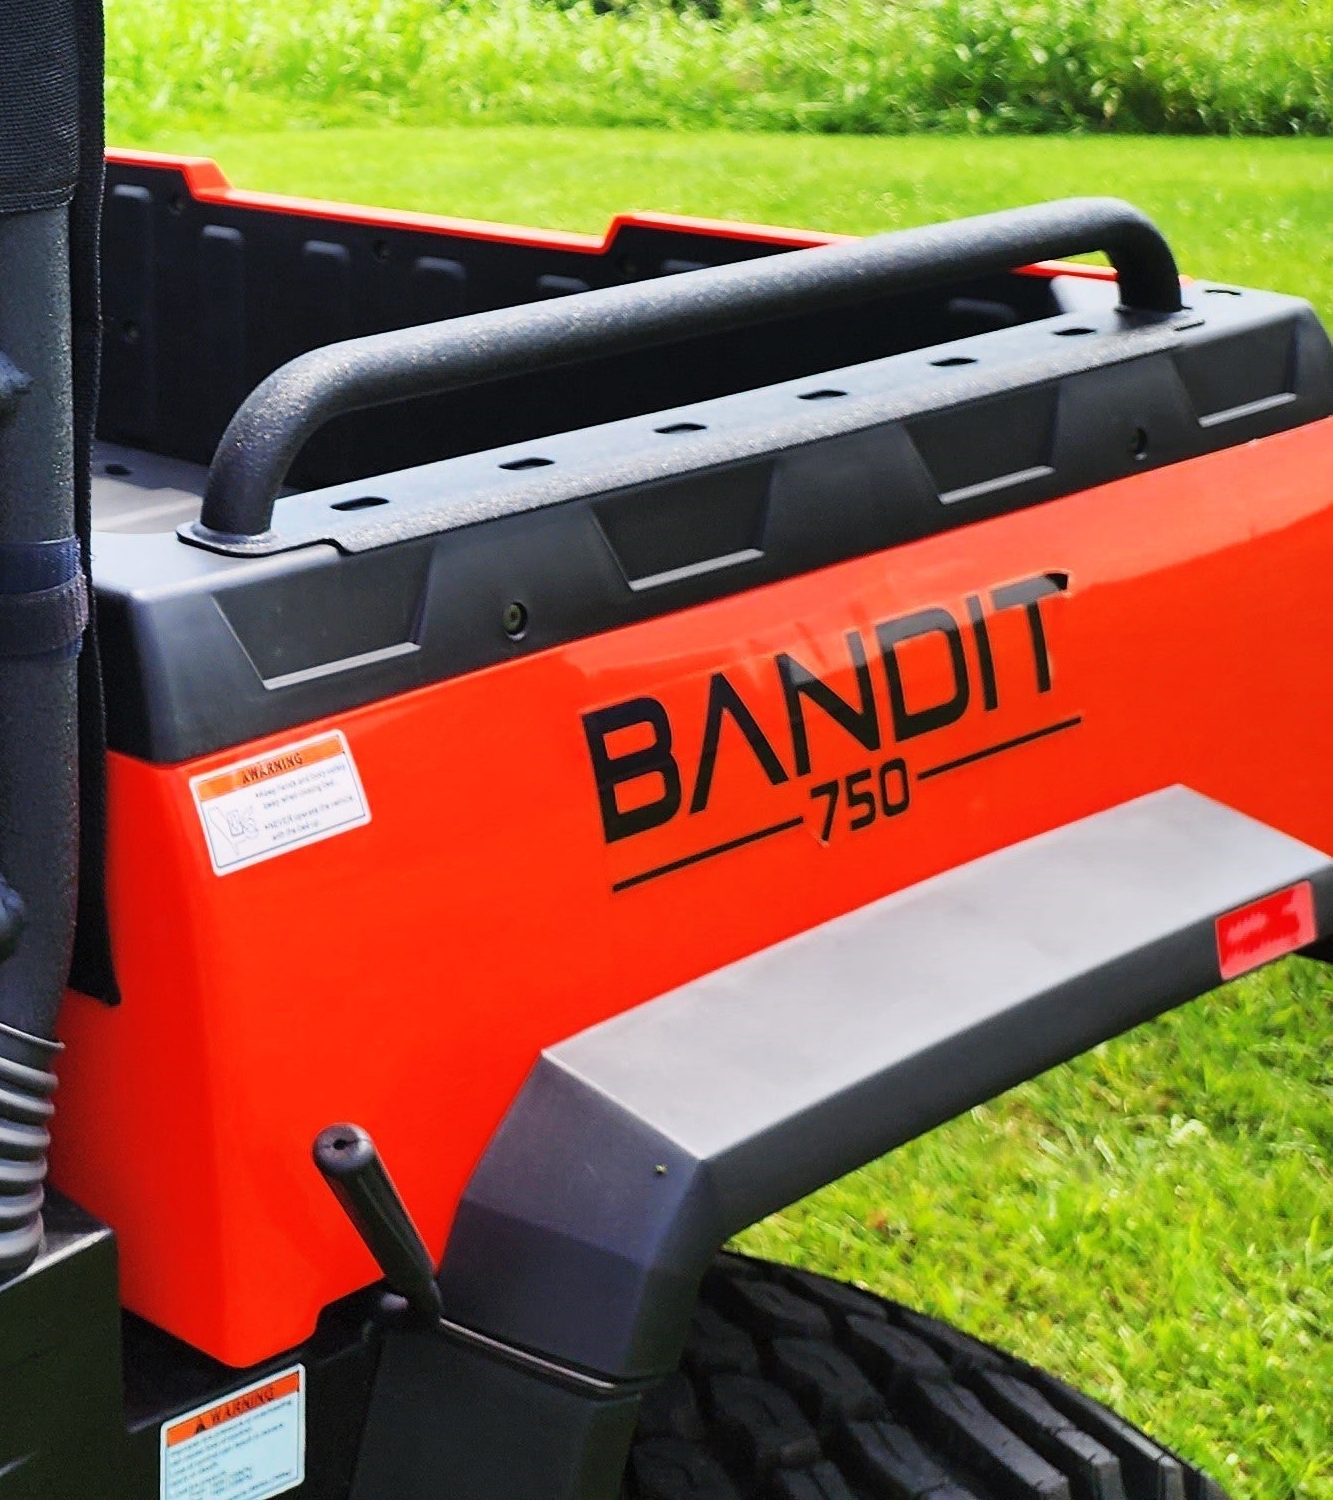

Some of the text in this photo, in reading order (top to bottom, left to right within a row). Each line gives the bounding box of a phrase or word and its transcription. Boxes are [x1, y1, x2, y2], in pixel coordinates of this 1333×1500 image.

[581, 570, 1071, 844] BANDIT
[249, 752, 304, 781] WARNING
[809, 757, 912, 843] 750
